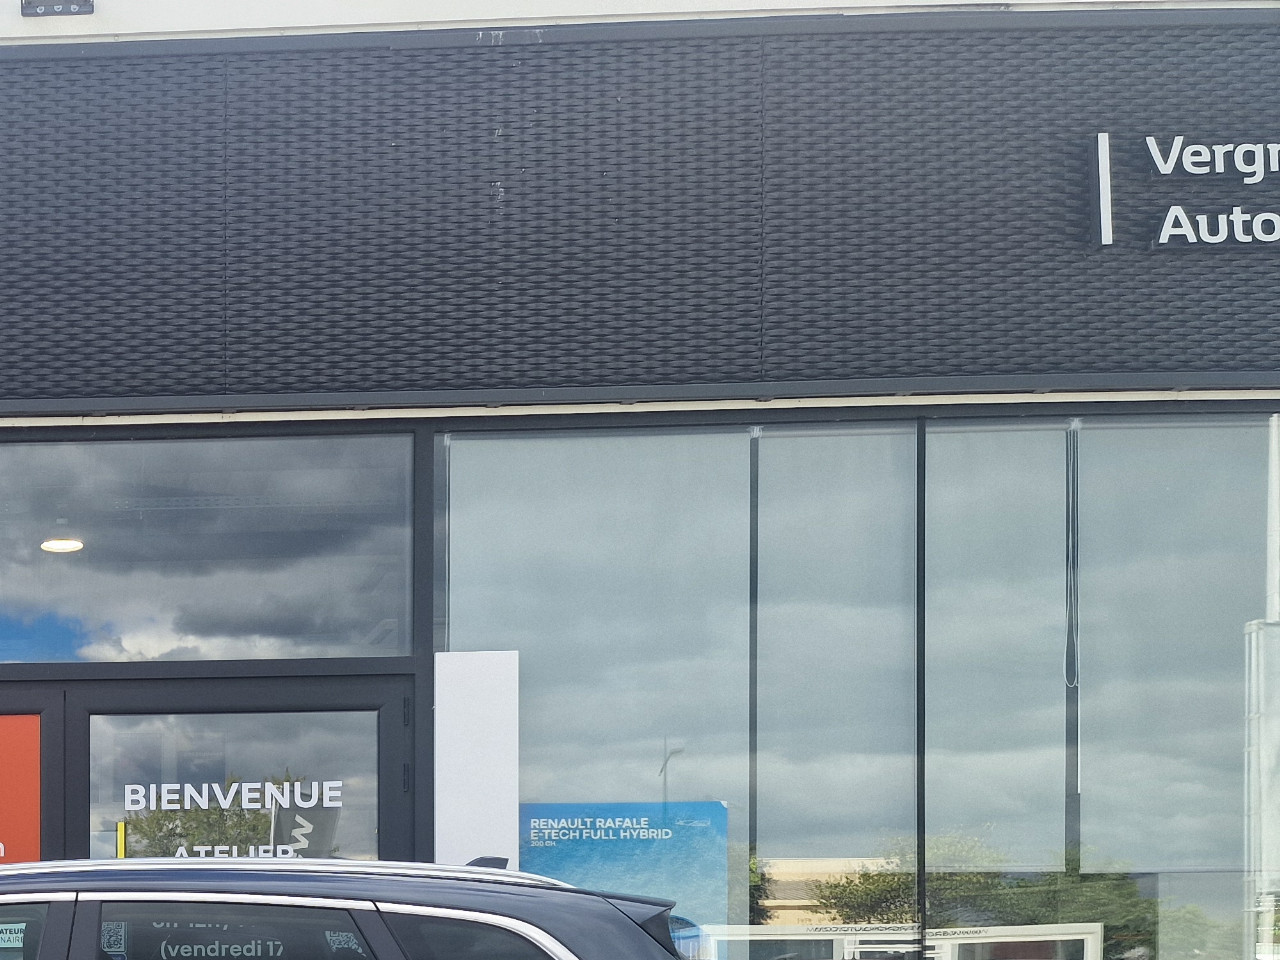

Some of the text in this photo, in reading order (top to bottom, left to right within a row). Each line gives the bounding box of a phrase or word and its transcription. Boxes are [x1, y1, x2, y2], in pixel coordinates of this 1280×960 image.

[1158, 205, 1280, 244] Auto
[124, 780, 343, 811] BIENVENUE
[530, 817, 649, 829] RENAULT RAFALE
[530, 828, 673, 840] E-TECH FULL HYBRID
